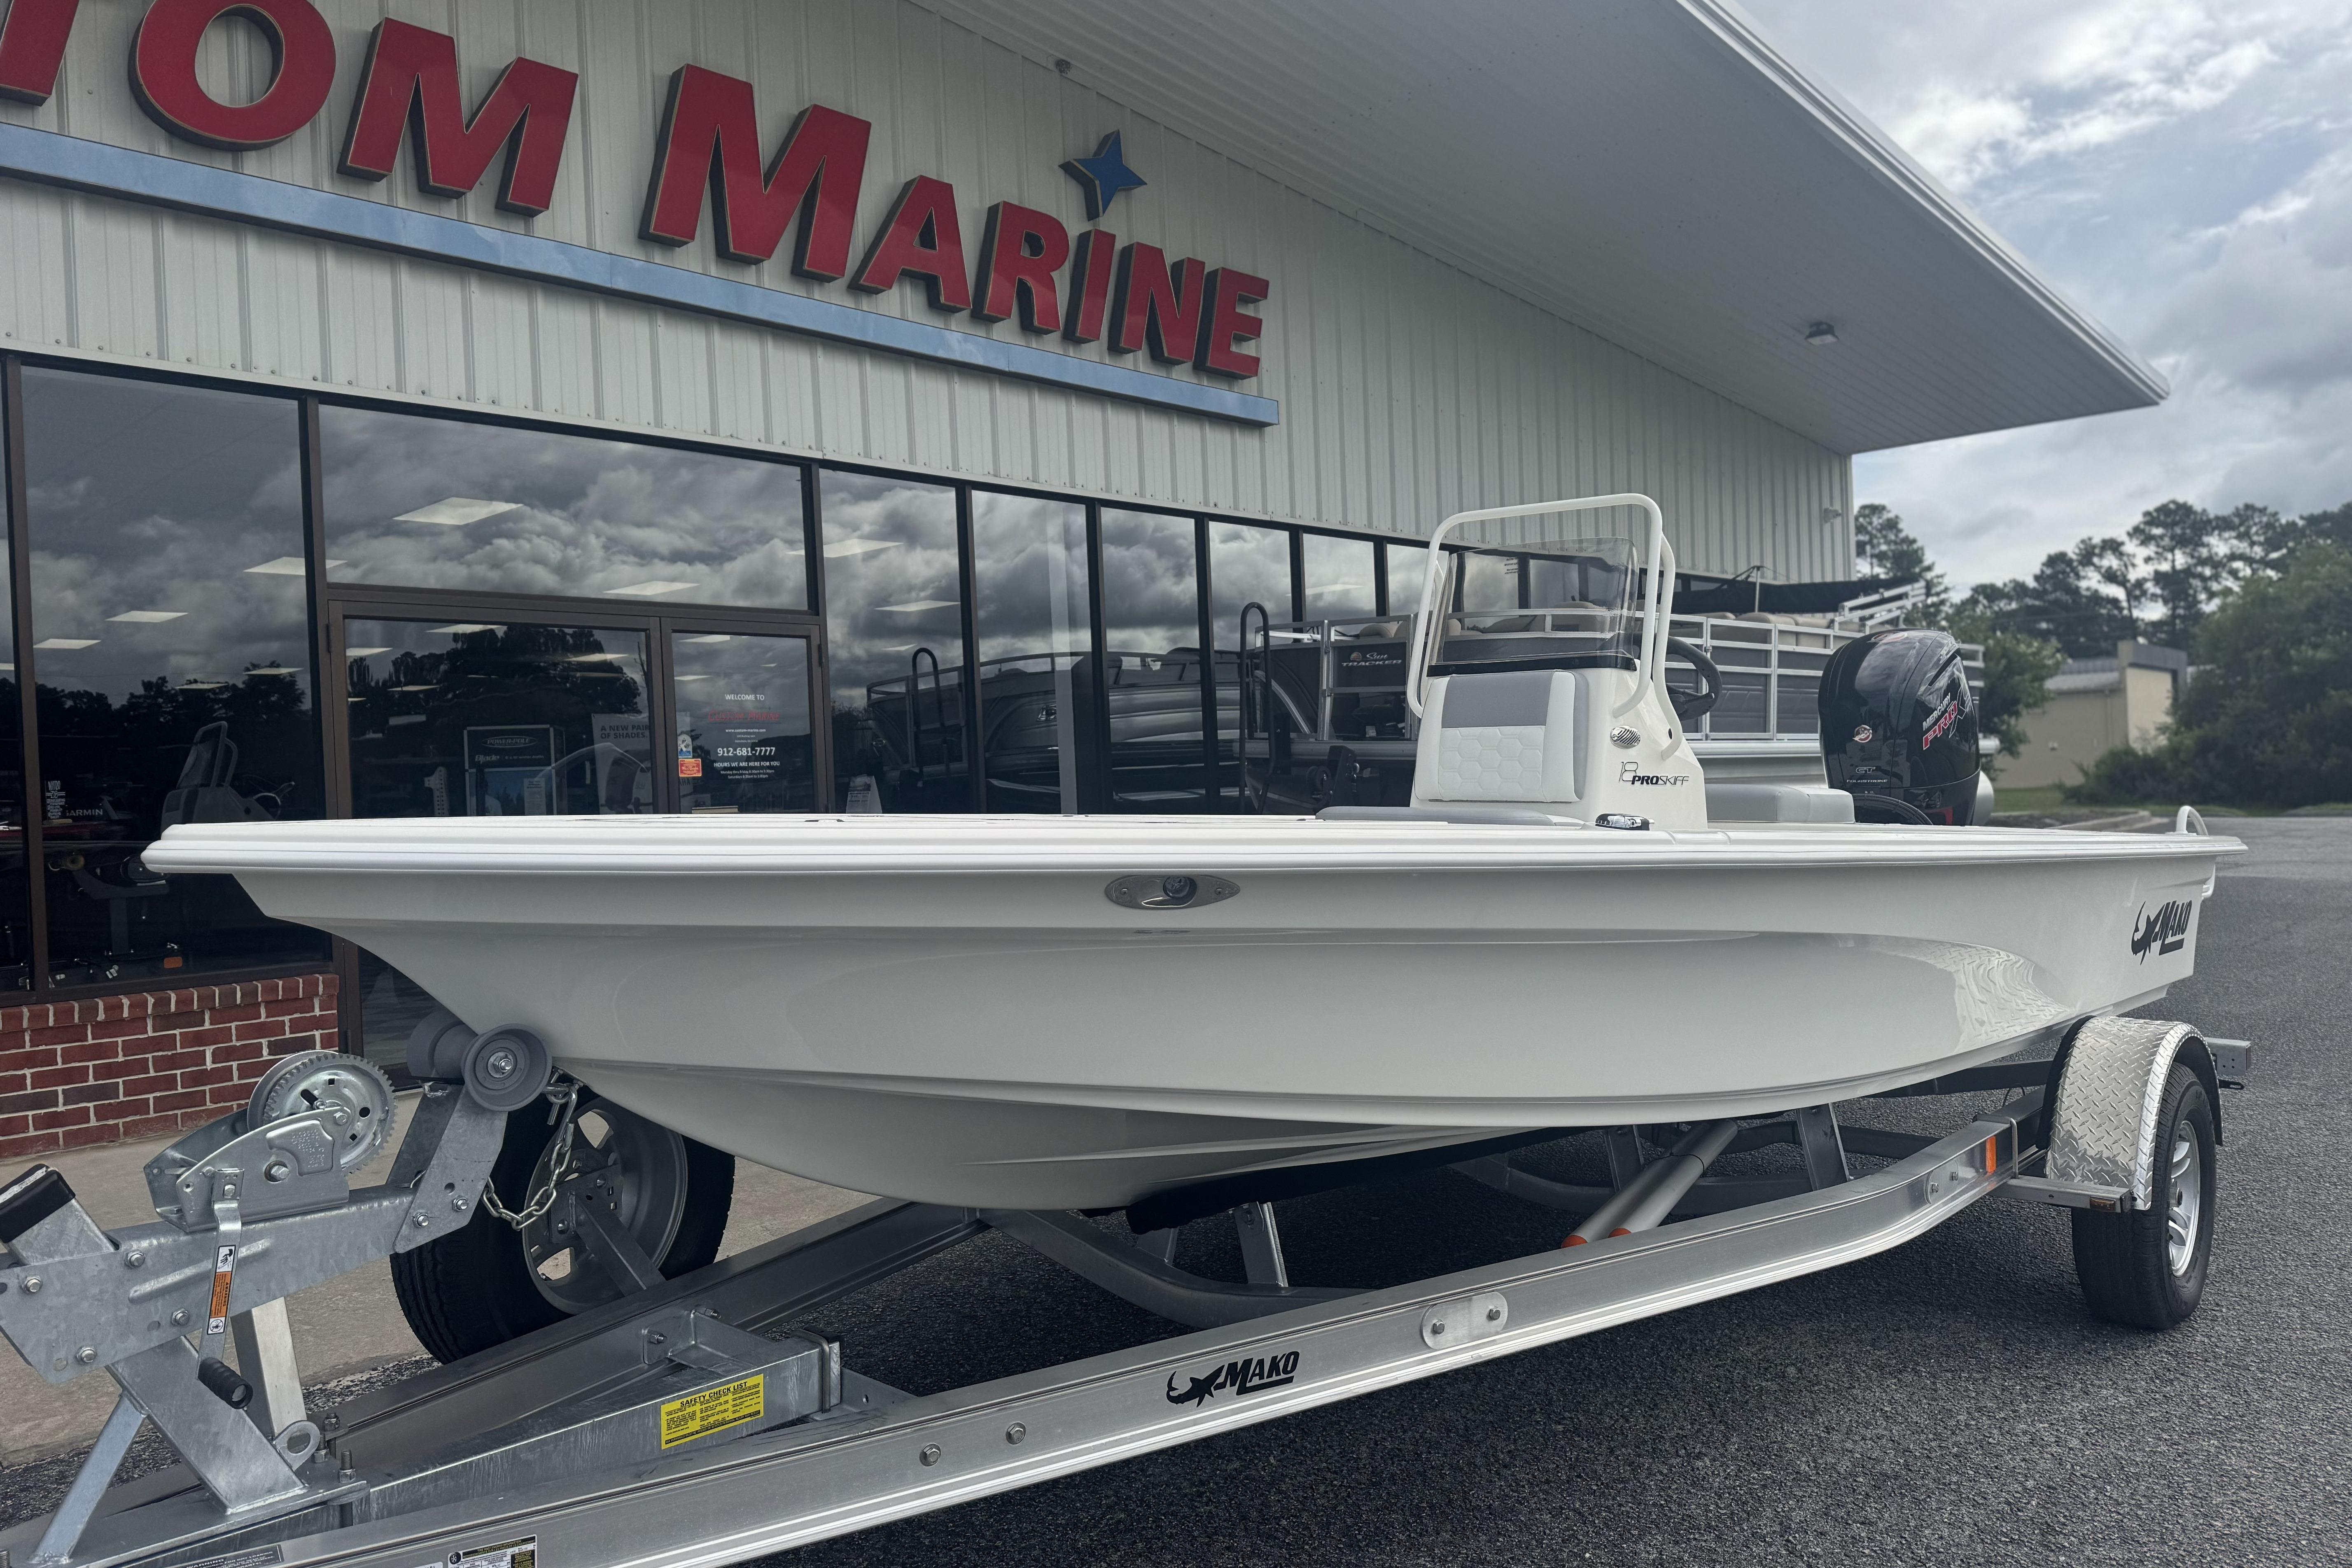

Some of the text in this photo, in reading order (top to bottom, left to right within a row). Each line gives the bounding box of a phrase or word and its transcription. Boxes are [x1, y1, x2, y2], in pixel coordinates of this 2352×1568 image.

[638, 63, 1269, 379] MARINE
[747, 711, 781, 721] MARINE
[1923, 693, 1951, 731] MERCURY
[717, 747, 775, 756] 912-681-7777
[2152, 900, 2193, 956] MAKO
[1214, 1351, 1300, 1395] MAKO
[680, 1381, 748, 1407] SAFETY CHECK LIST
